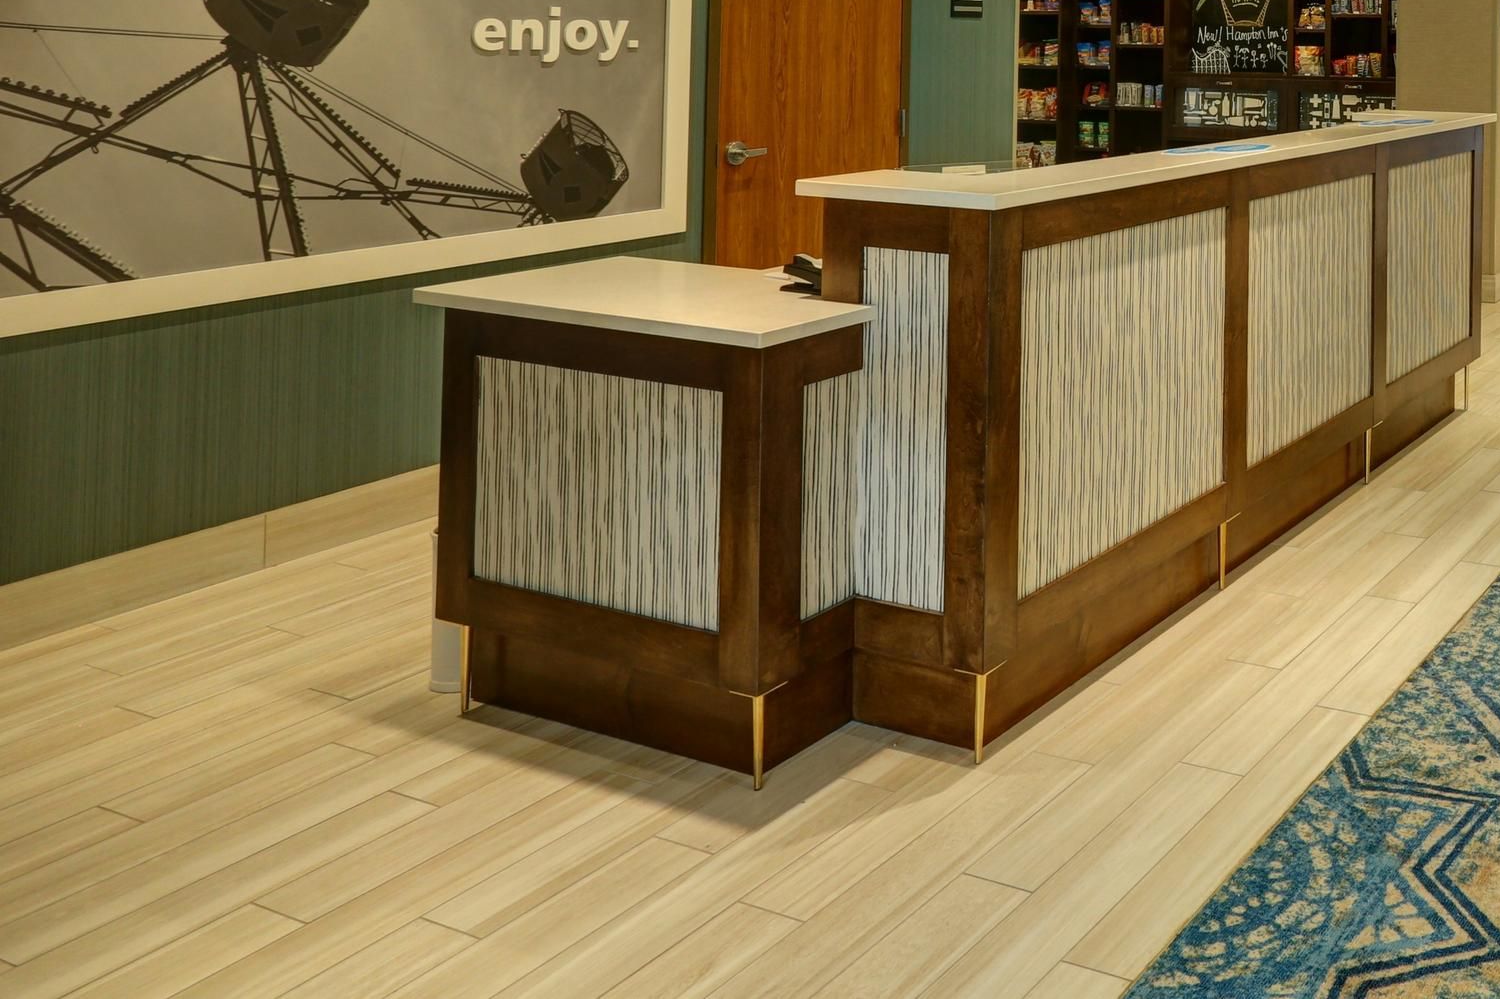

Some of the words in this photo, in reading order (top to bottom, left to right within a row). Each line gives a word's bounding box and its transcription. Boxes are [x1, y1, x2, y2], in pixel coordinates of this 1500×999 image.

[473, 6, 639, 63] enjoy.
[1197, 26, 1222, 44] New!
[1226, 26, 1266, 45] Hampton
